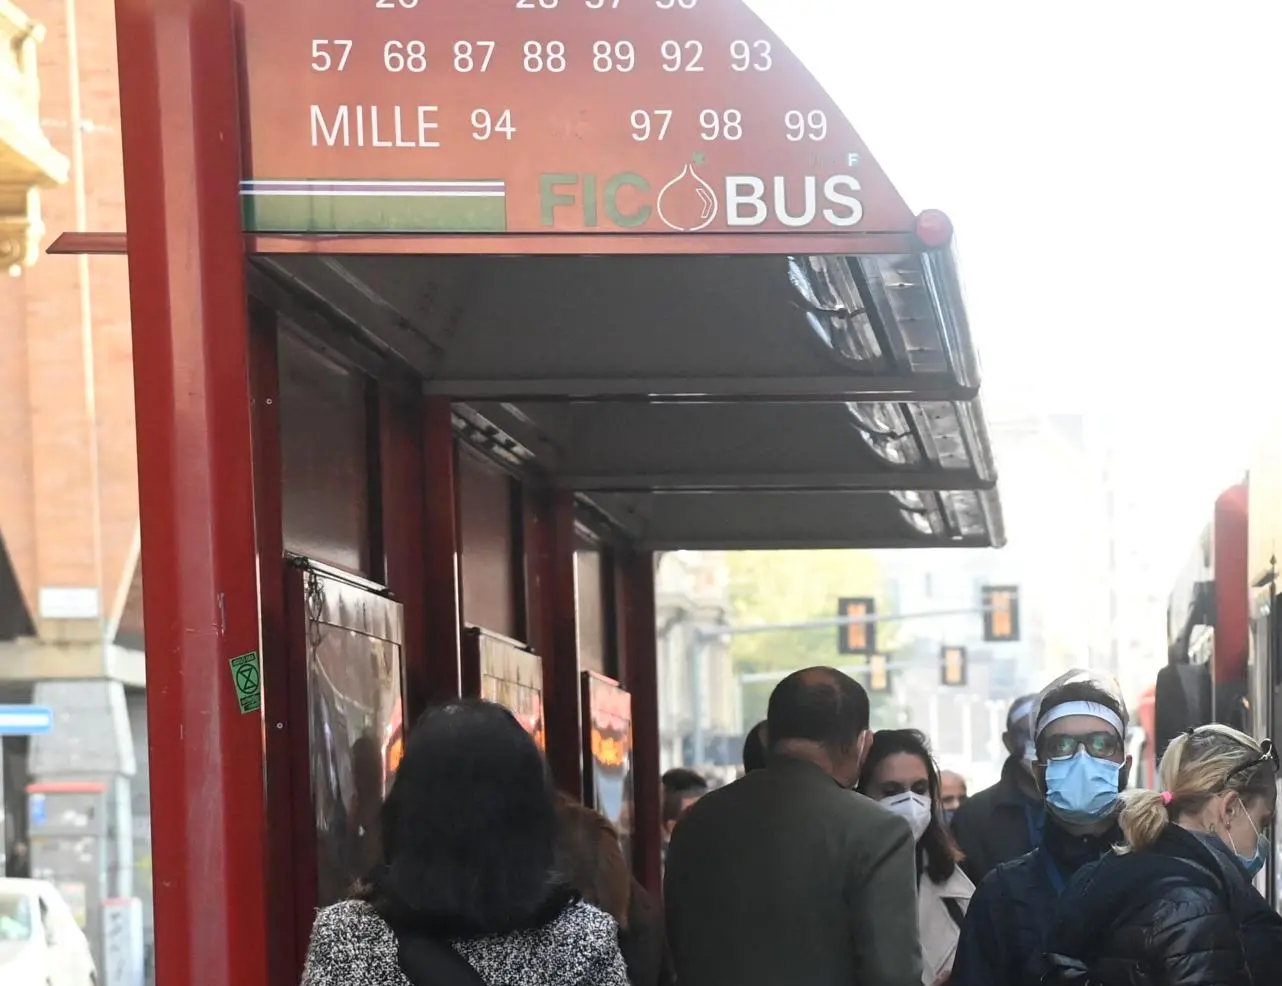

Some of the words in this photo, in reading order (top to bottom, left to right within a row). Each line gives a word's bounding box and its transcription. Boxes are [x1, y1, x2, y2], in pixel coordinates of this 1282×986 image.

[311, 39, 353, 71] 57
[383, 40, 427, 72] 68
[453, 40, 496, 72] 87
[523, 40, 566, 72] 88
[592, 40, 635, 72] 89
[660, 40, 705, 72] 92
[729, 40, 773, 72] 93
[310, 105, 440, 147] MILLE
[470, 108, 516, 140] 94
[630, 110, 673, 140] 97
[699, 109, 743, 141] 98
[784, 110, 828, 141] 99
[725, 175, 863, 227] BUS
